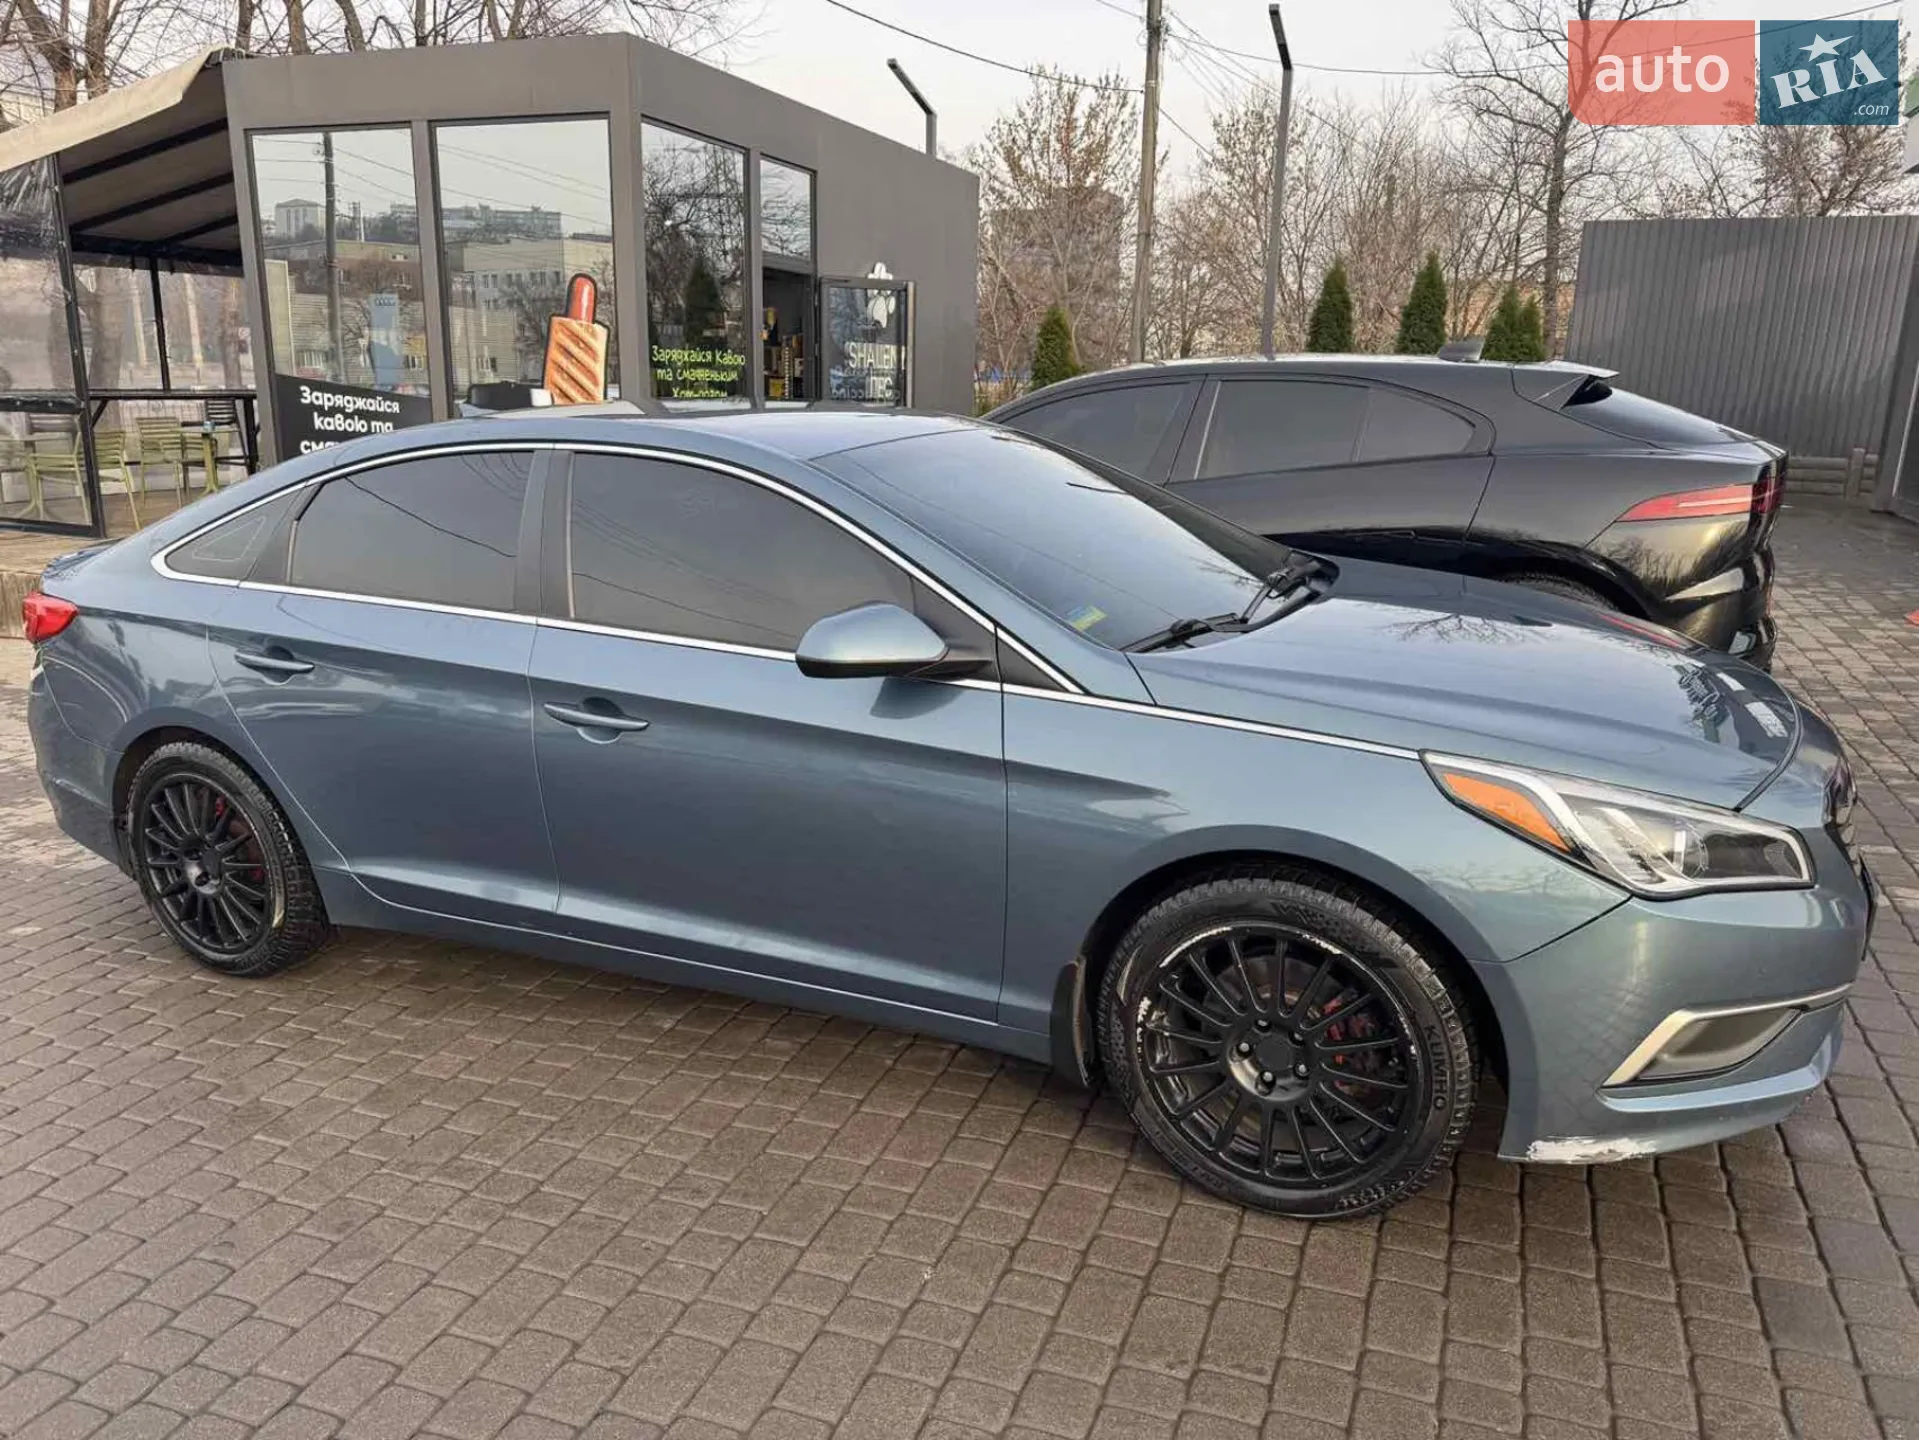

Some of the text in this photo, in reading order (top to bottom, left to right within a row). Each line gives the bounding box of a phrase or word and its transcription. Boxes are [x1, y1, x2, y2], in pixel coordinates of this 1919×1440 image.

[299, 385, 401, 414] Заряджайся
[313, 412, 394, 433] кавою та
[1424, 1025, 1448, 1109] KUMHO
